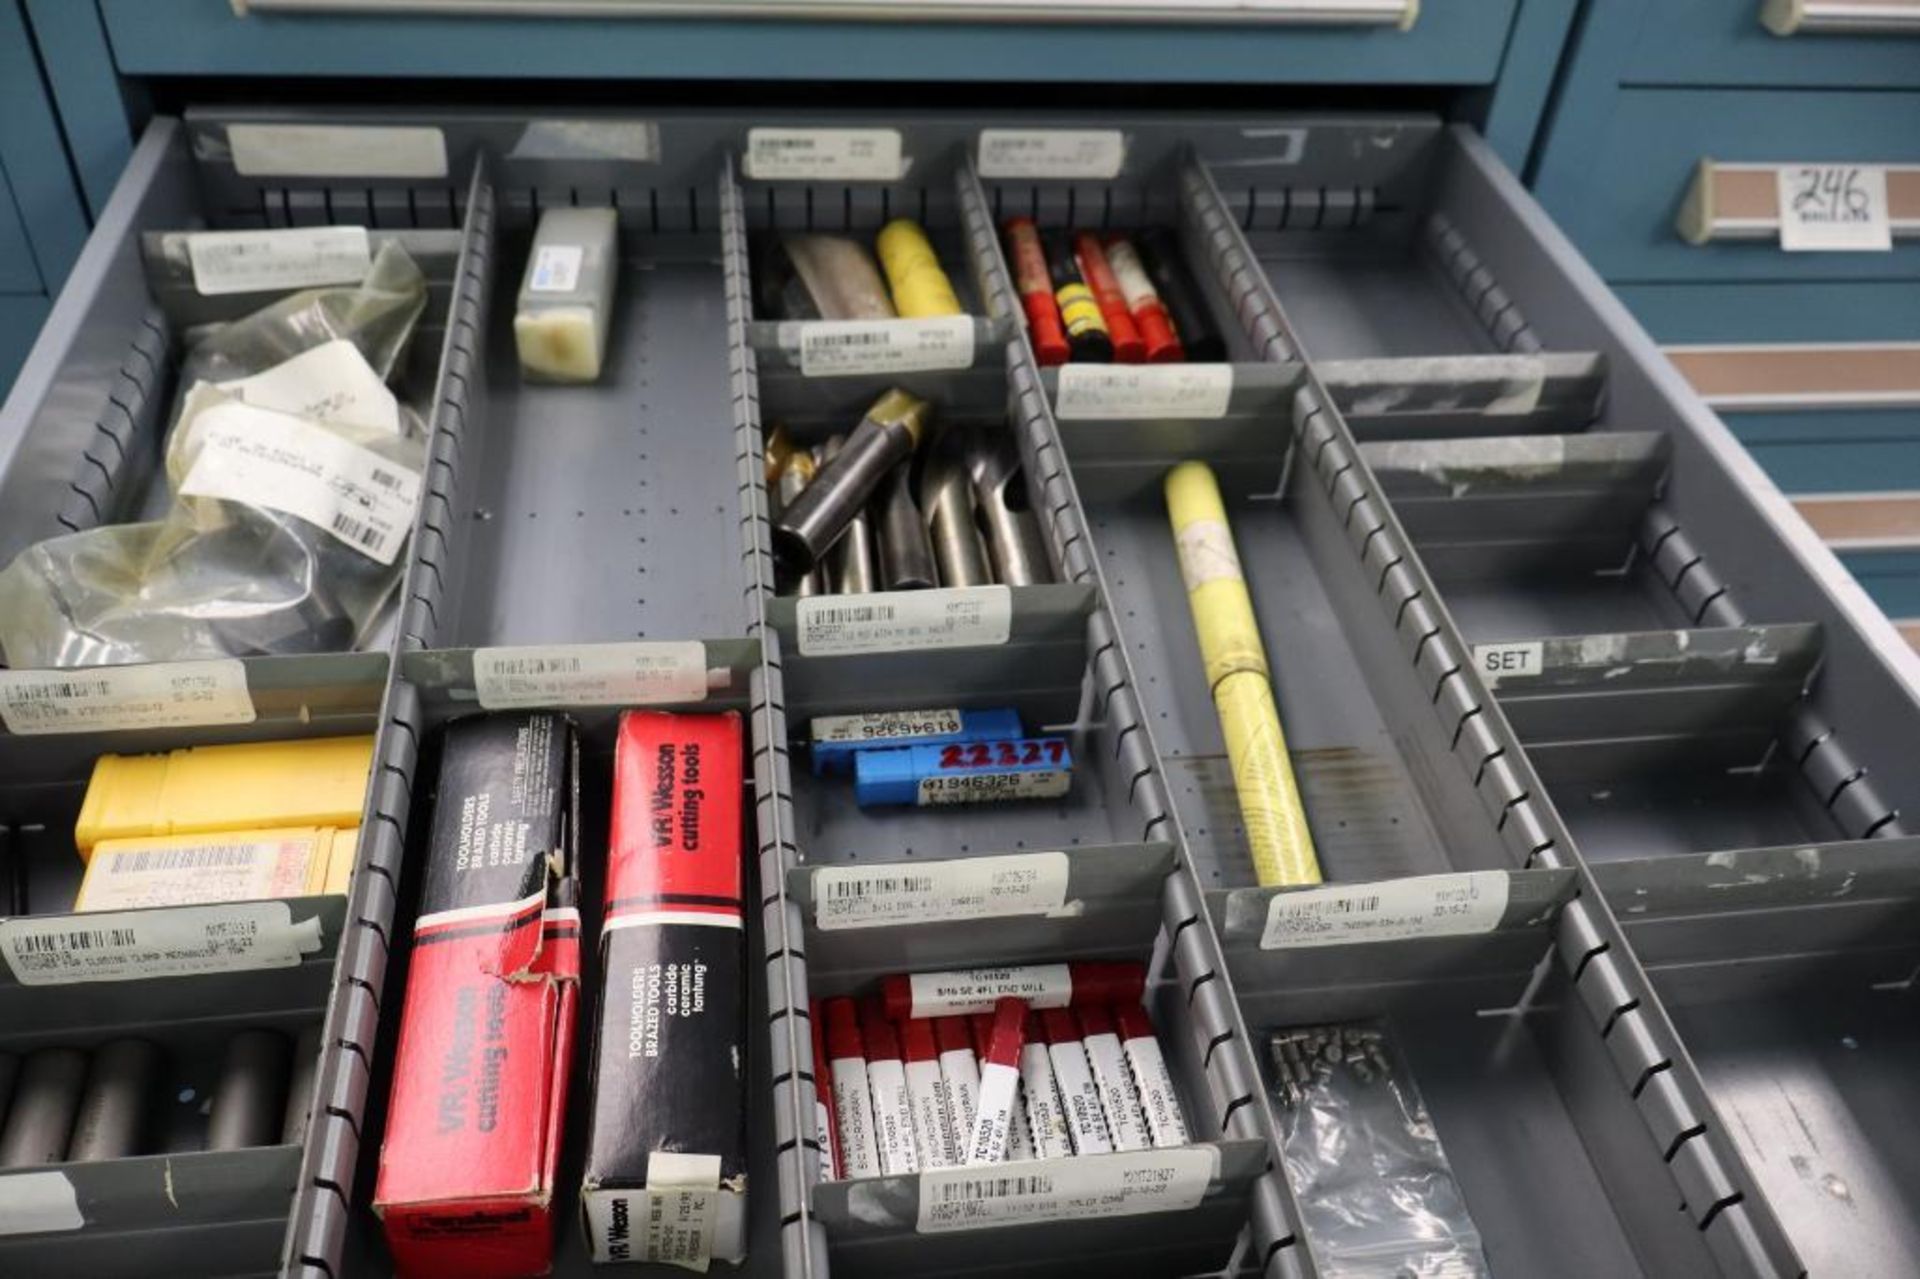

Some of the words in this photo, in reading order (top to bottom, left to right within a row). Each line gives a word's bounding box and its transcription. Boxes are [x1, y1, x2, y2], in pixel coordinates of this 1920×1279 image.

[1793, 169, 1869, 221] 246
[1485, 650, 1531, 672] SET
[680, 743, 700, 785] tools
[475, 793, 491, 827] TOOLS
[678, 790, 704, 851] cutting
[648, 964, 661, 1006] TOOLS
[665, 963, 678, 1015] carbide
[679, 963, 692, 1017] ceramic
[645, 1007, 659, 1058] BRAZED
[476, 1048, 508, 1133] cutting
